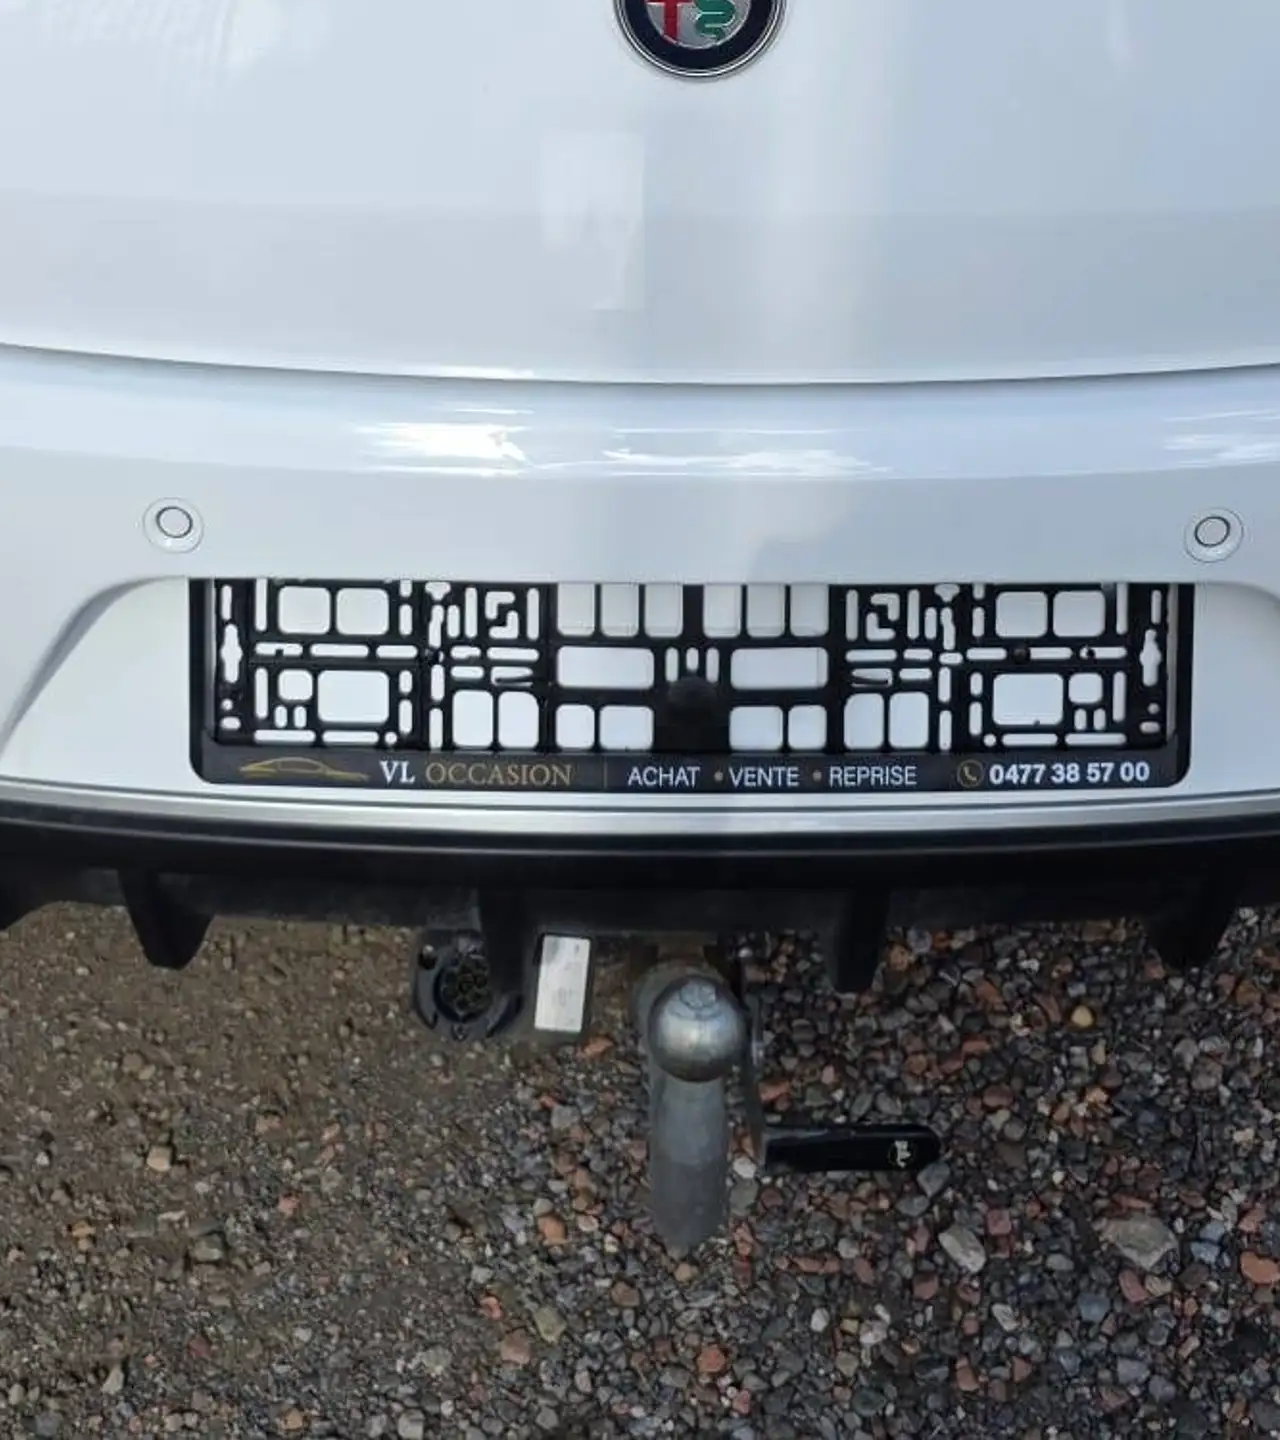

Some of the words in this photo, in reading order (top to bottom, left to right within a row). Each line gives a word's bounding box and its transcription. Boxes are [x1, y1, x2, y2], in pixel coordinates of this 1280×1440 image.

[379, 760, 416, 784] VL
[425, 762, 572, 786] OCCASION
[627, 765, 701, 788] ACHAT
[728, 765, 800, 788] VENTE
[828, 764, 918, 787] REPRISE
[988, 763, 1046, 785] 0477
[1050, 762, 1080, 784] 38
[1086, 761, 1115, 783] 57
[1119, 760, 1150, 782] 00
